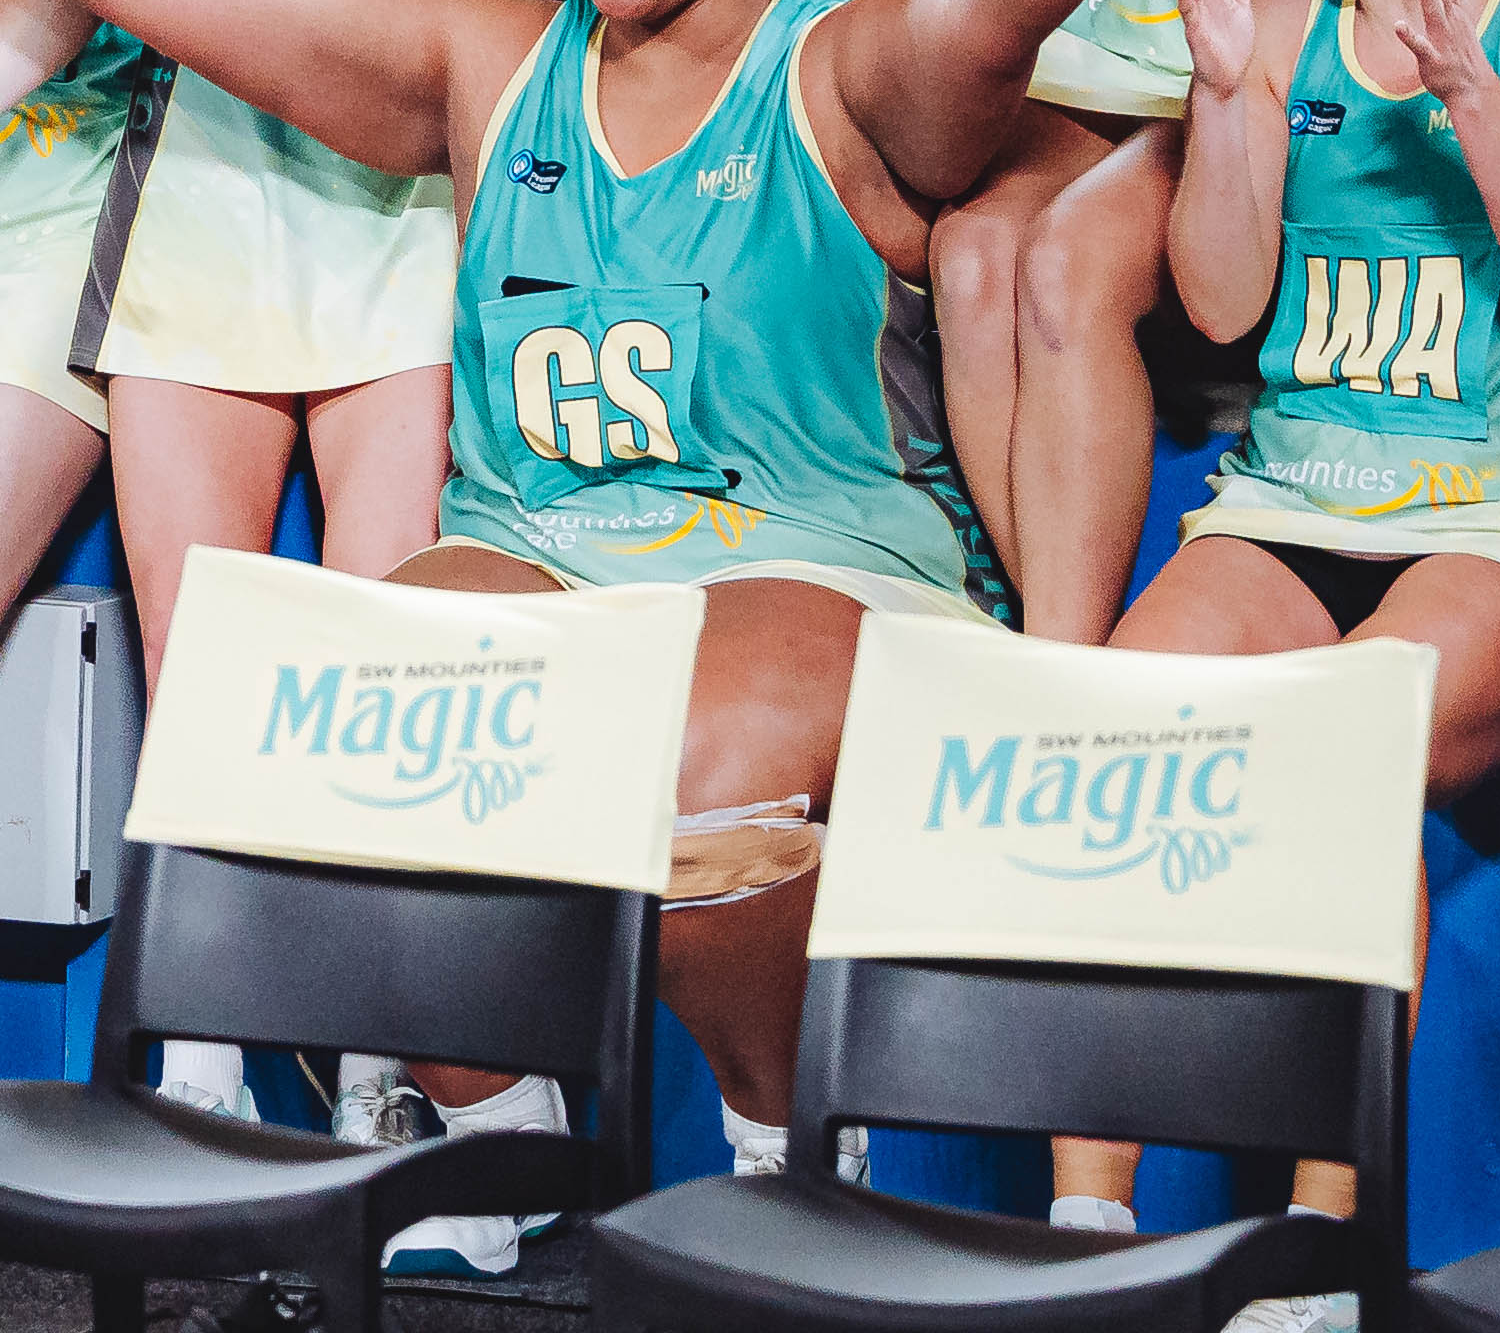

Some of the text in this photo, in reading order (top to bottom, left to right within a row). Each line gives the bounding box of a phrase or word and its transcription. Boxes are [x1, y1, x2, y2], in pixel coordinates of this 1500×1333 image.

[1293, 255, 1468, 403] WA
[512, 319, 681, 468] GS
[257, 664, 543, 783] Magic
[355, 656, 546, 679] SW MOUNTIES
[924, 735, 1248, 852] Magic
[1034, 723, 1254, 751] SW MOUNTIES
